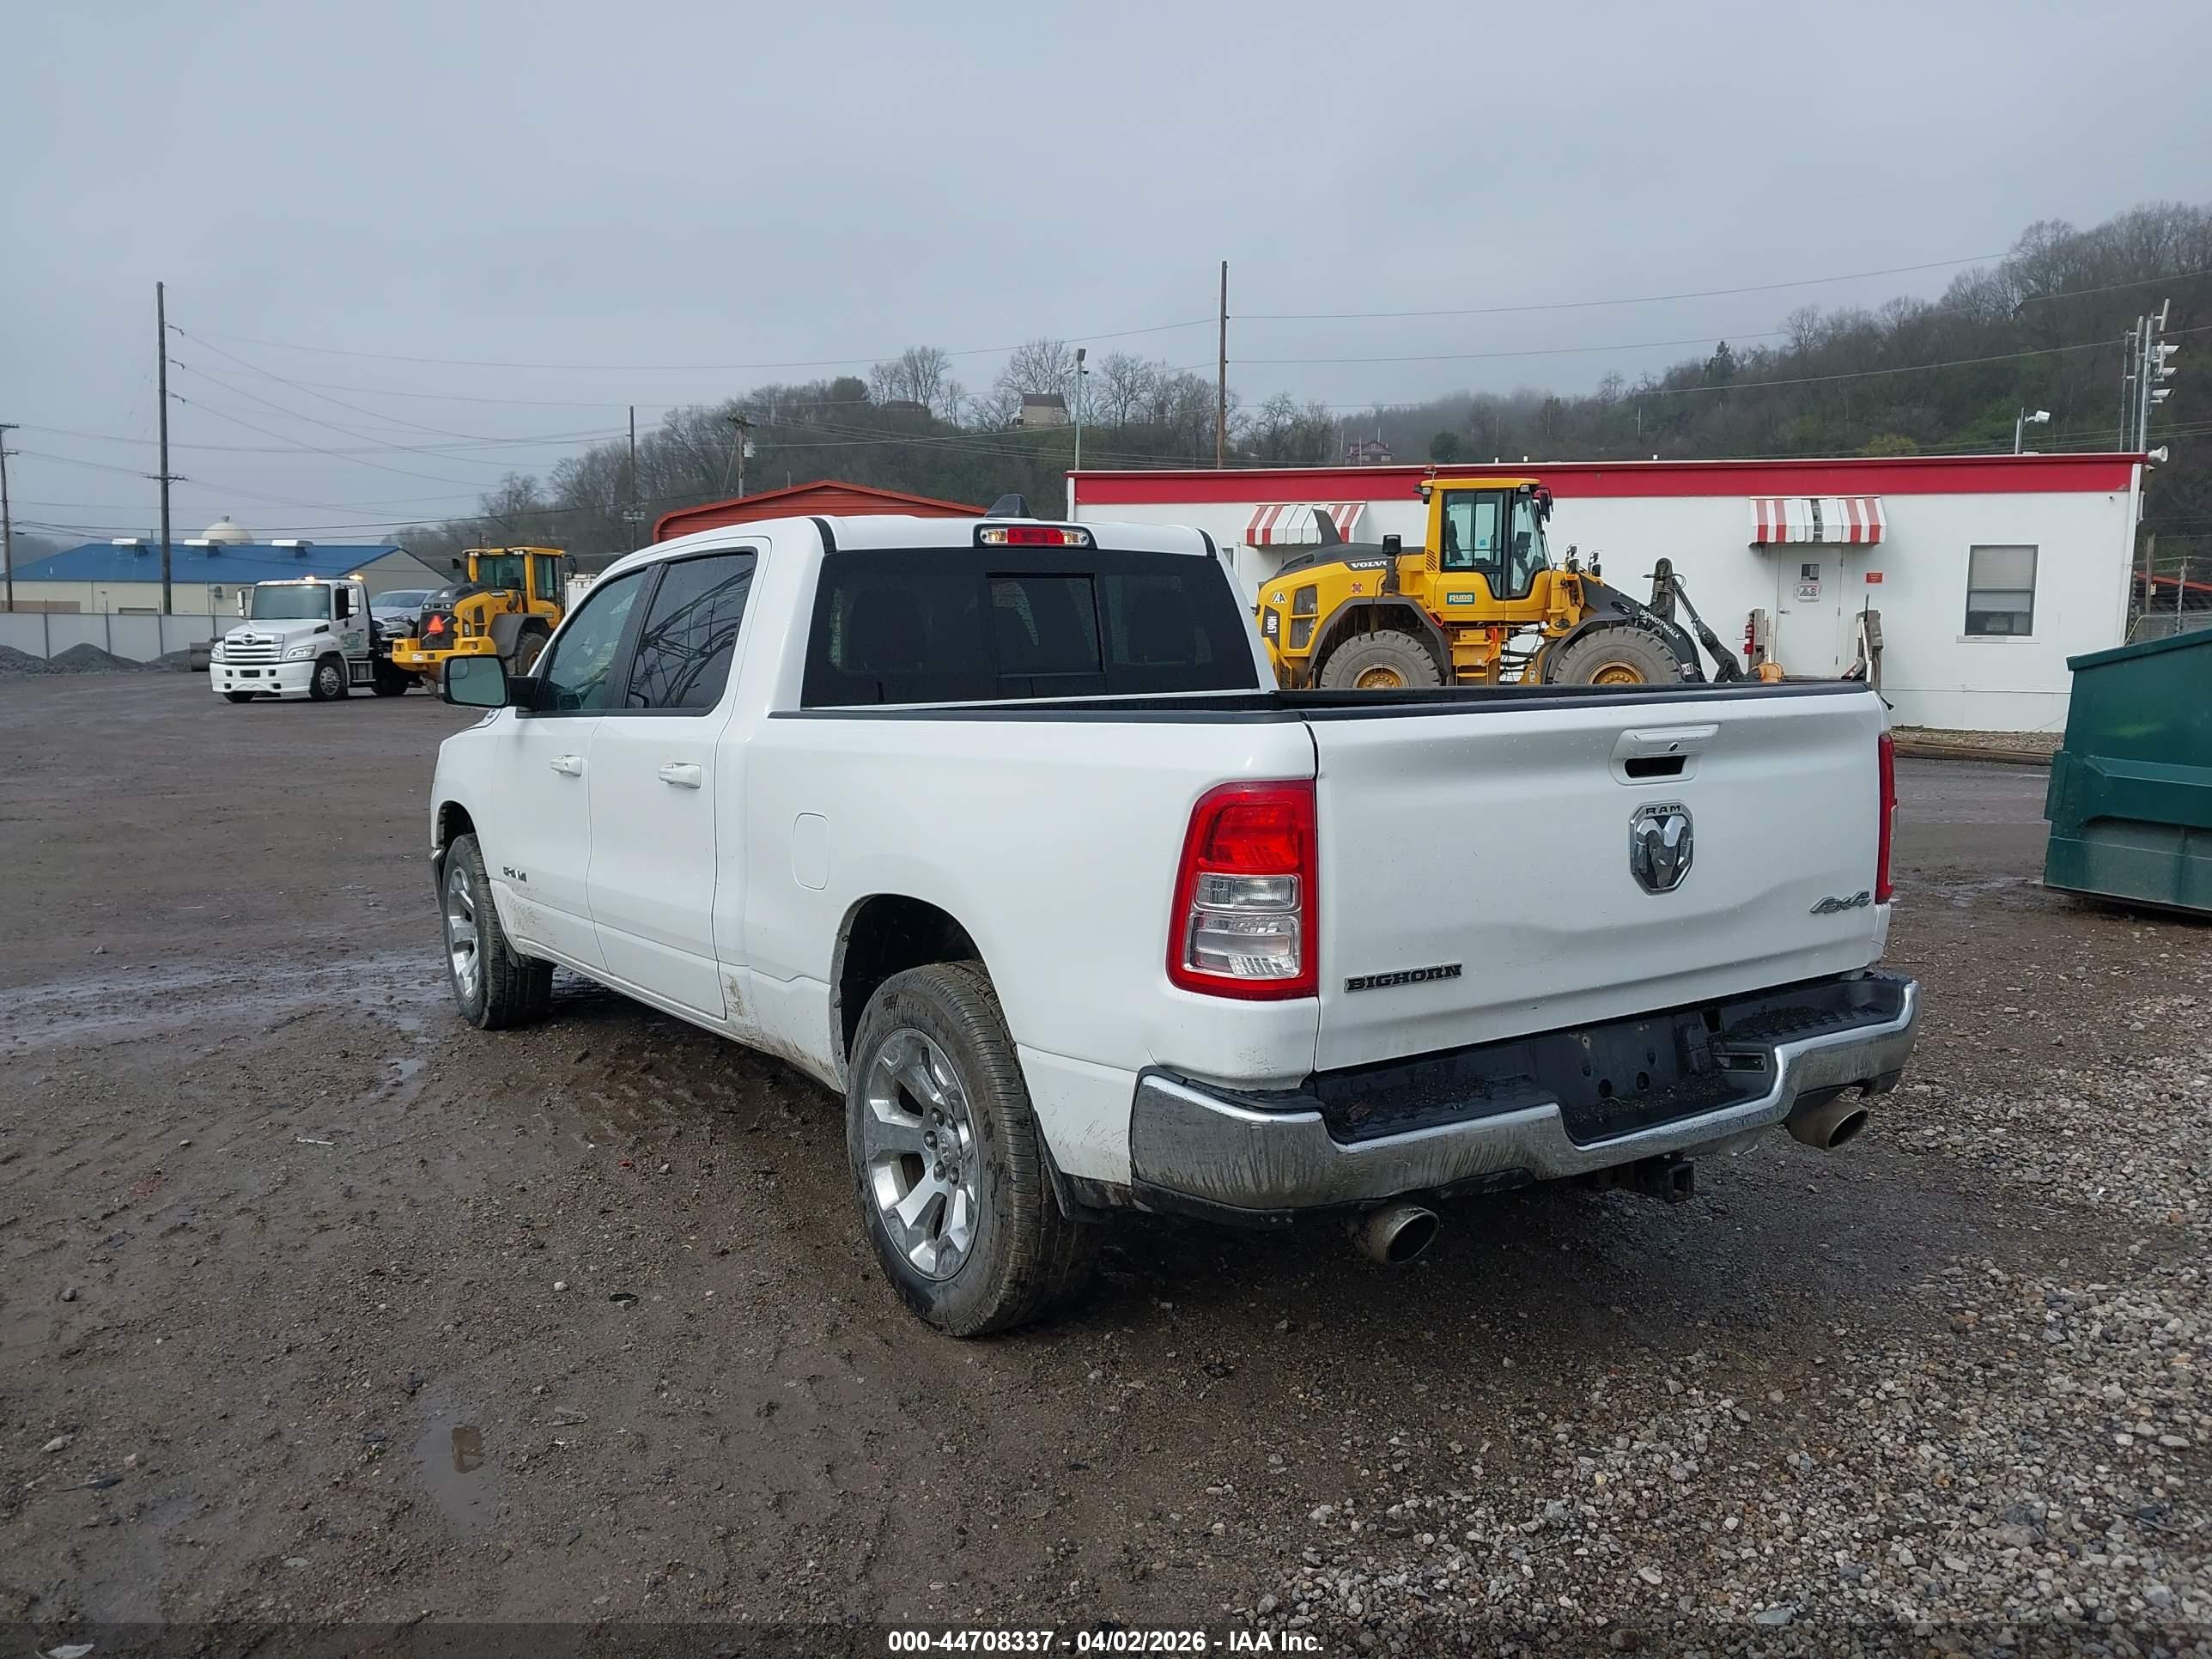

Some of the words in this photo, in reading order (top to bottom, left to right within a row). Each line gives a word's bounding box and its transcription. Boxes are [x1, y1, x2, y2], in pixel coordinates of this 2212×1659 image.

[1267, 616, 1278, 634] L90H
[1645, 805, 1681, 815] RAM
[1345, 963, 1463, 993] BIGHORN
